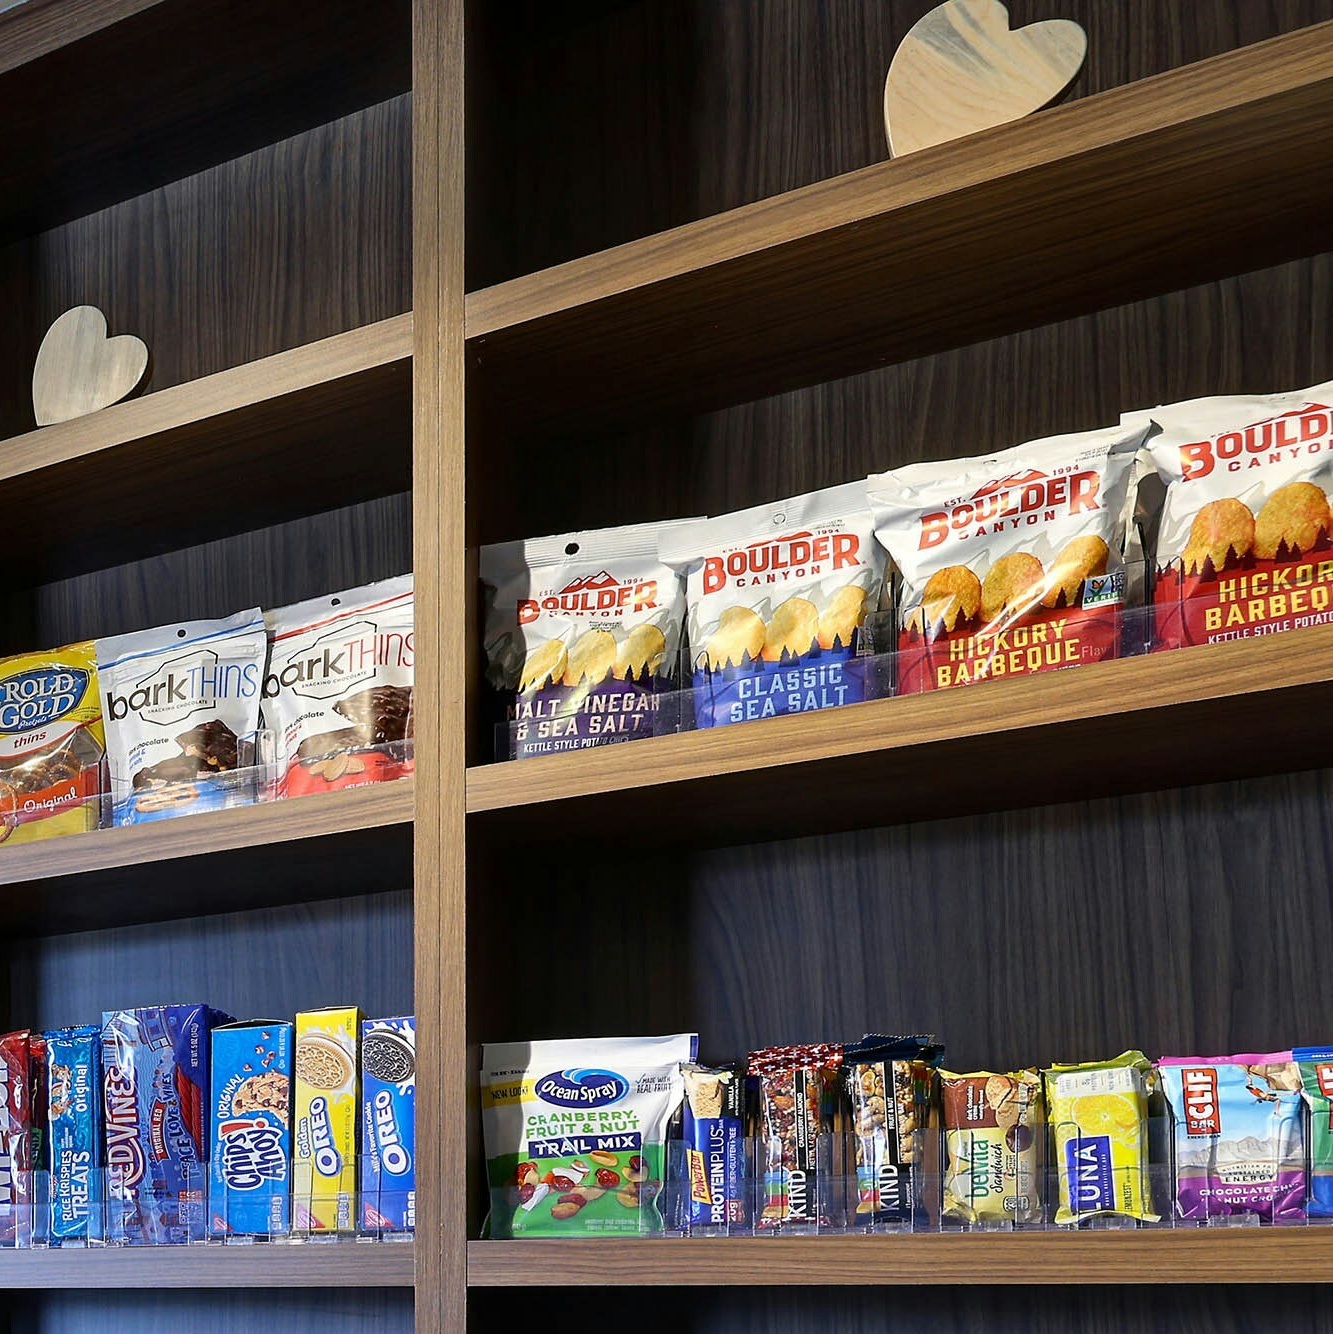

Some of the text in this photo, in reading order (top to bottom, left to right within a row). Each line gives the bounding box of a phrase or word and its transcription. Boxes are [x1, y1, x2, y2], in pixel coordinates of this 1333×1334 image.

[1052, 464, 1080, 476] 1994
[919, 470, 1103, 551] BOULDER
[957, 509, 1056, 541] CANYON
[703, 534, 861, 595] BOULDER
[736, 564, 821, 589] CANYON
[1218, 562, 1333, 604] HICKOR
[517, 580, 658, 626] BOULDER
[1204, 590, 1333, 631] BARBEQ
[949, 619, 1067, 661] HICKORY
[738, 663, 843, 699] CLASSIC
[937, 638, 1081, 687] BARBEQUE
[4, 673, 75, 703] ROLD
[507, 693, 660, 721] MALT VINEGAR
[730, 685, 848, 723] SEA SALT
[13, 731, 47, 749] thins
[517, 715, 644, 741] & SEA SALT
[523, 740, 552, 753] KETTLE
[553, 738, 578, 751] STYLE
[23, 788, 78, 814] Original
[74, 1065, 90, 1112] Original
[216, 1074, 245, 1118] ORIGINAL
[540, 1079, 617, 1103] Ocean Spray
[1186, 1068, 1214, 1119] CLIF
[152, 1108, 164, 1154] ORIGINAL RED
[299, 1118, 308, 1159] Golden
[311, 1097, 342, 1177] OREO
[376, 1091, 411, 1176] OREO
[526, 1120, 640, 1140] FRUIT & NUT
[535, 1135, 635, 1156] TRAIL MIX
[61, 1151, 73, 1221] RICE KRISPIES
[72, 1151, 91, 1219] TREATS
[879, 1164, 900, 1211] KIND
[990, 1143, 1002, 1194] Sandwich
[1225, 1174, 1274, 1184] ENERGY
[787, 1170, 807, 1218] KIND
